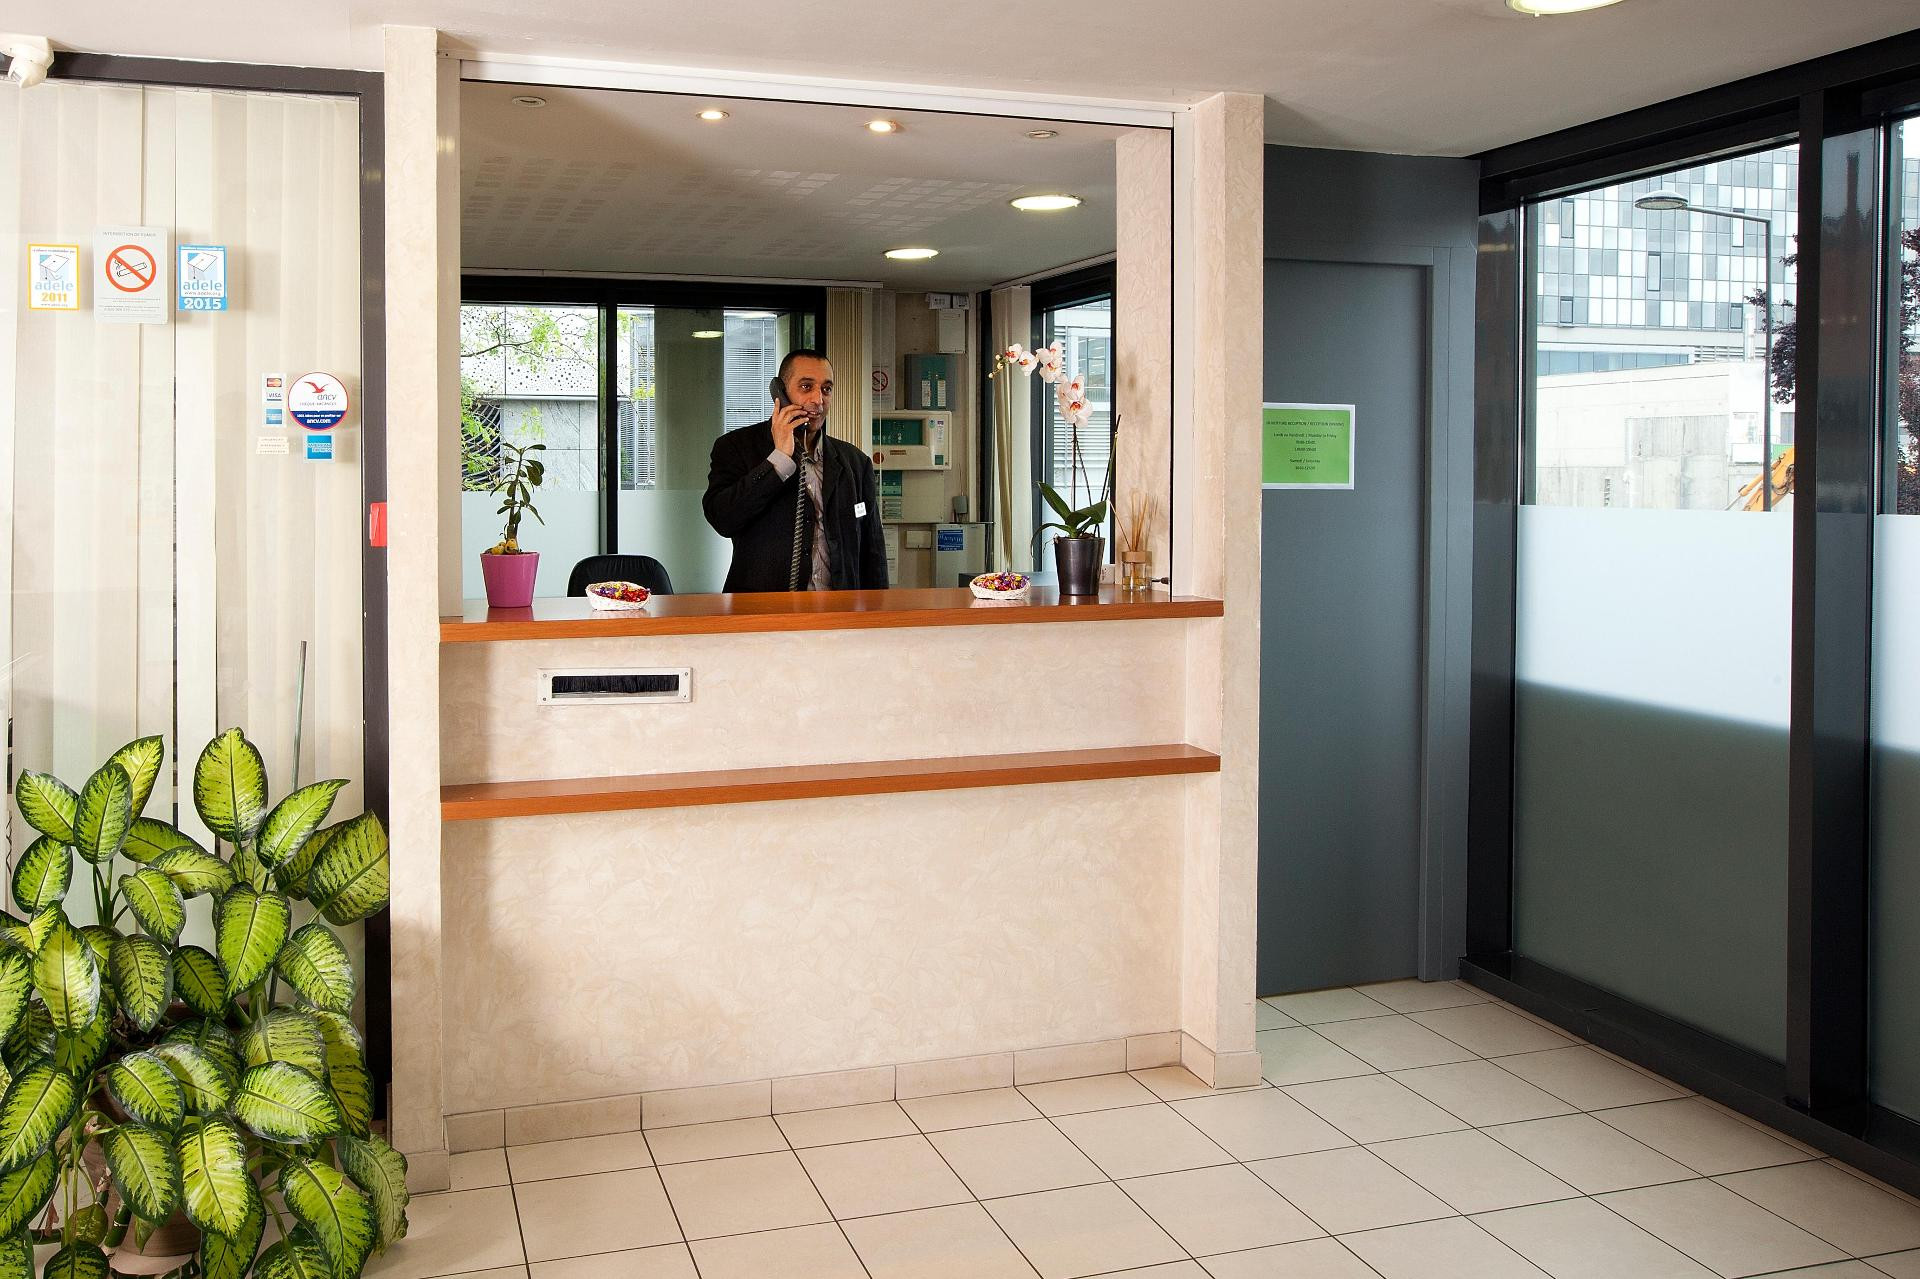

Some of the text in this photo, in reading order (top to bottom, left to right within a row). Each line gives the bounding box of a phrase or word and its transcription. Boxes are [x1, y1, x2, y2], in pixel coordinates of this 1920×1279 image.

[35, 280, 74, 291] adele
[183, 279, 222, 291] adele
[40, 292, 67, 302] 2011
[183, 297, 222, 310] 2015
